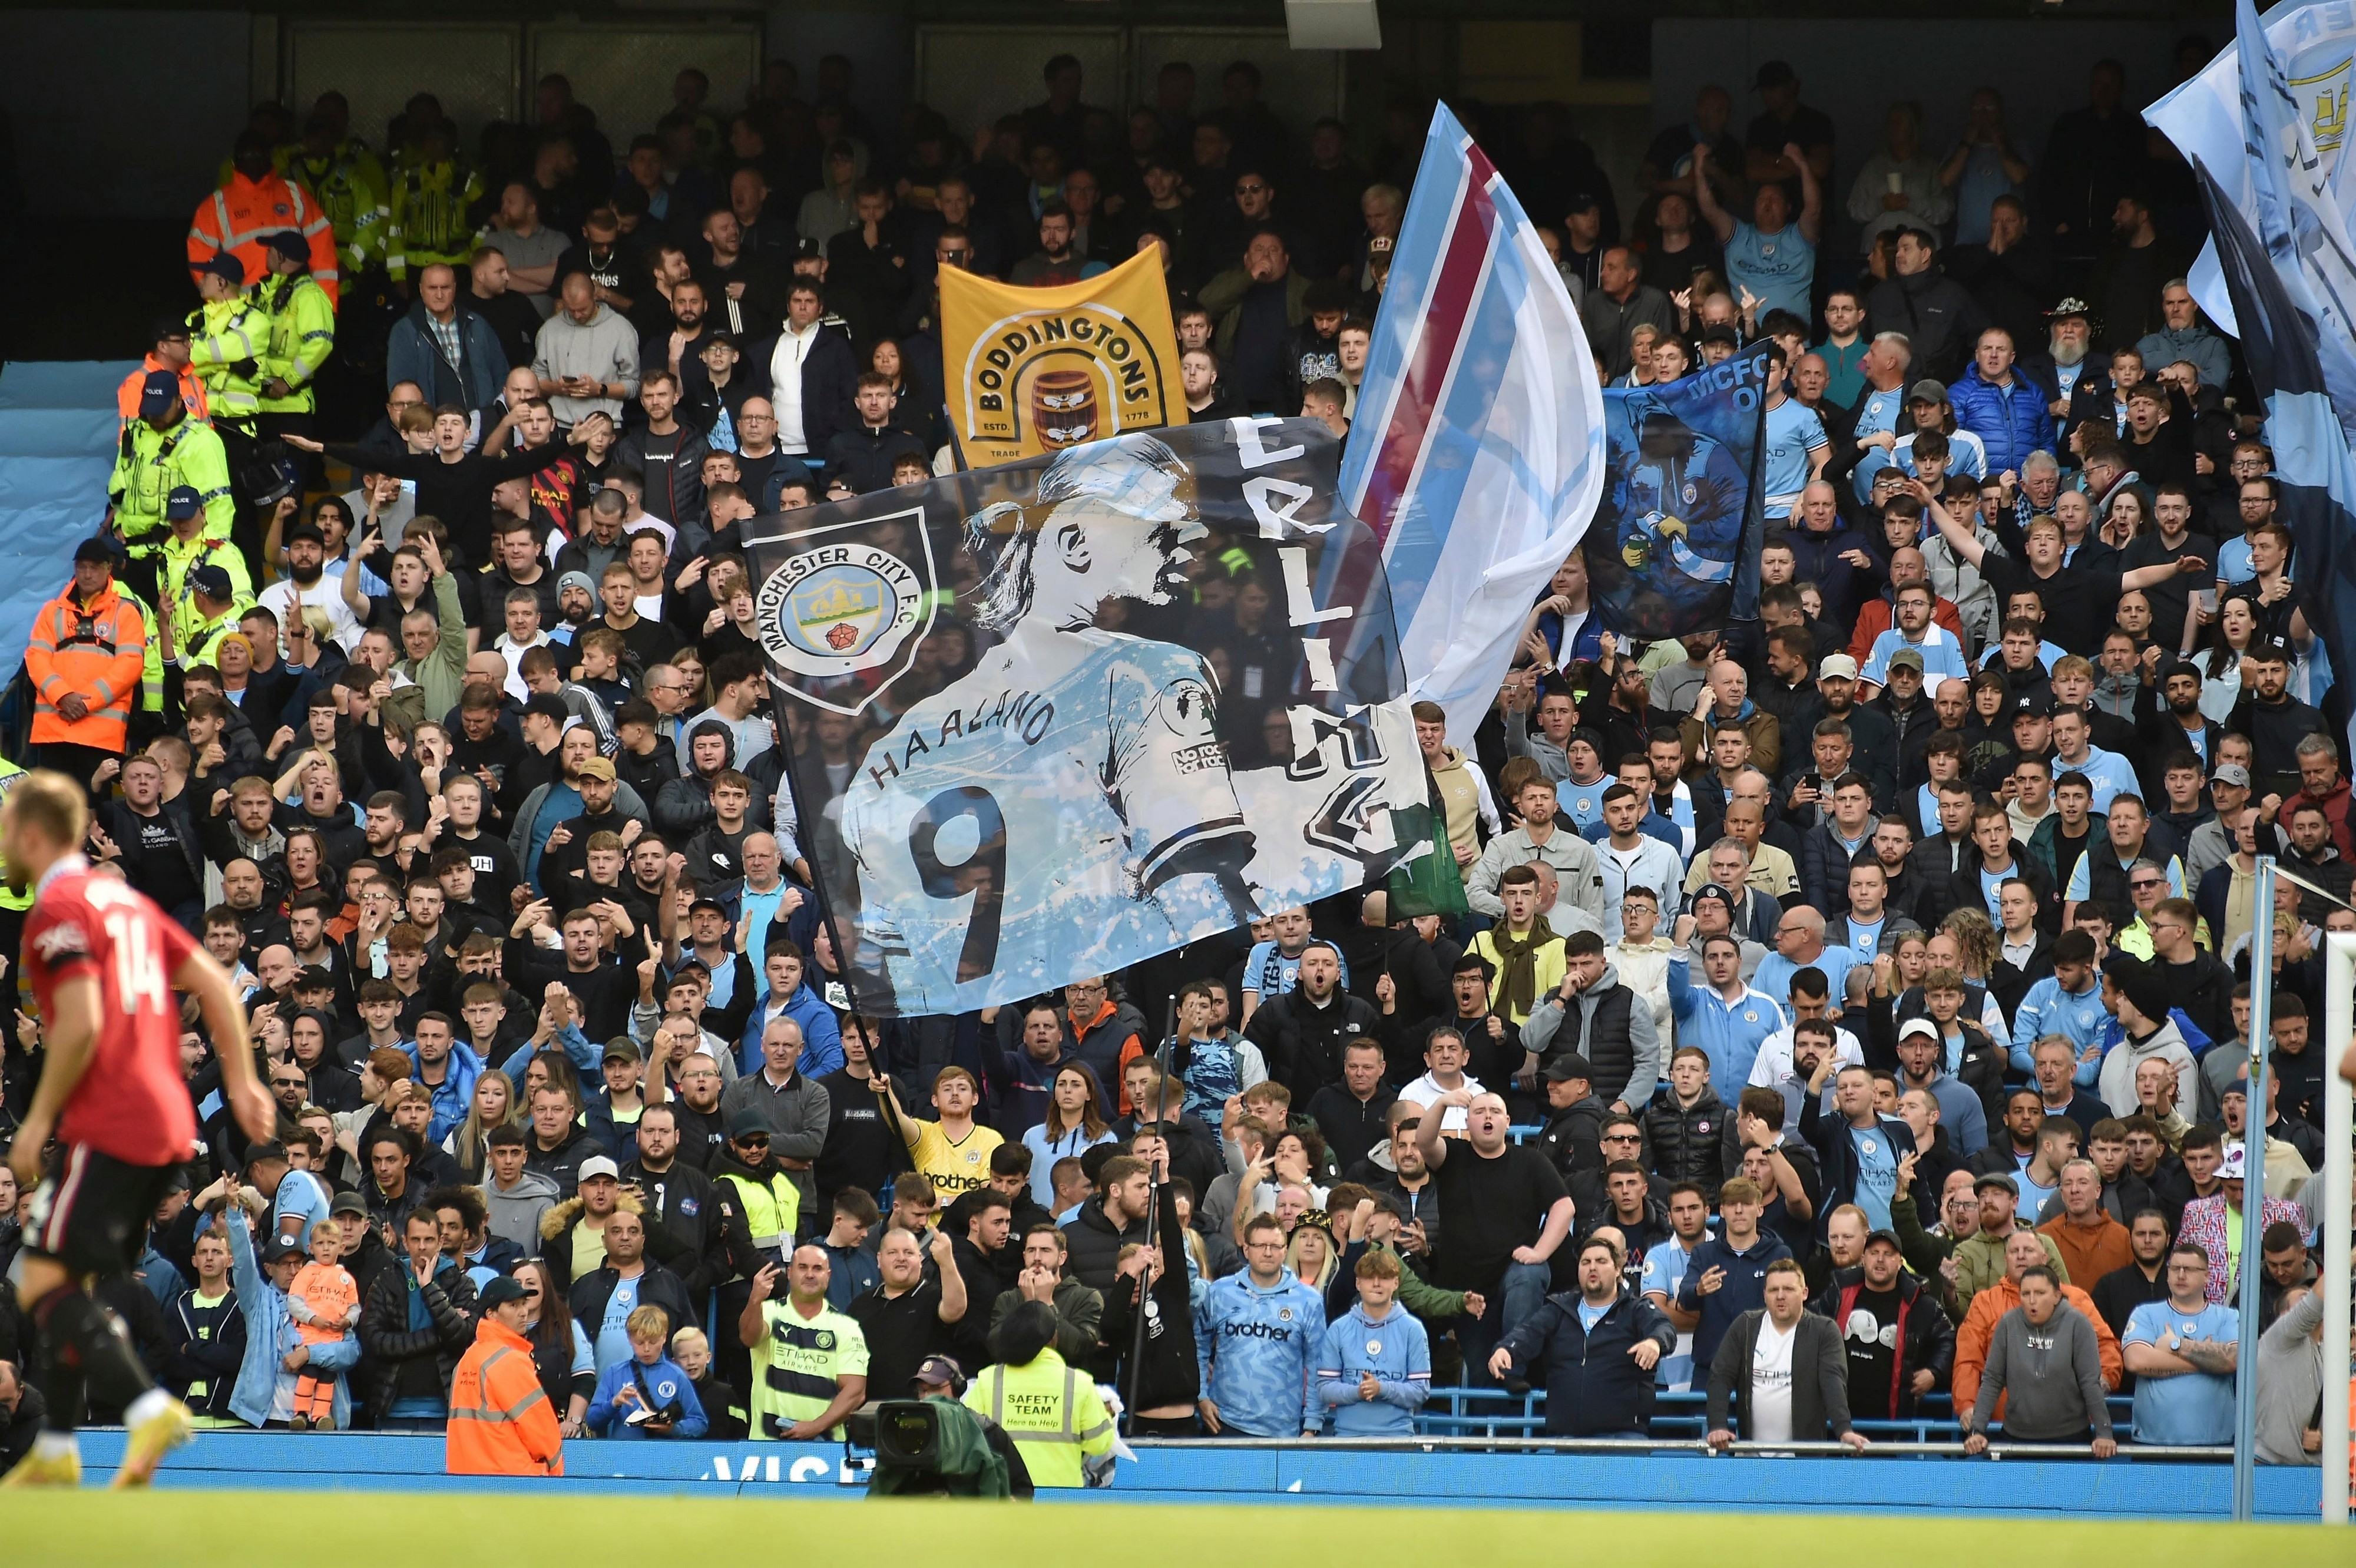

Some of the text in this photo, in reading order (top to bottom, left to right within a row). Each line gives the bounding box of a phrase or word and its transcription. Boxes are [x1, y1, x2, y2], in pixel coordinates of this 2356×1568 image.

[978, 316, 1149, 412] BODDINGTONS
[1125, 411, 1149, 422] 1778
[983, 423, 1011, 432] ESTD.
[991, 449, 1021, 458] TRADE
[759, 547, 918, 652] MANCHESTER CITY F.C.
[908, 785, 1008, 985] 9
[104, 915, 166, 1016] 14
[1225, 1321, 1292, 1343] brother
[775, 1346, 828, 1365] ETIHAD
[781, 1359, 818, 1373] AIRWAYS
[1007, 1394, 1058, 1404] SAFETY
[1015, 1405, 1051, 1415] TEAM
[1038, 1420, 1059, 1429] Help
